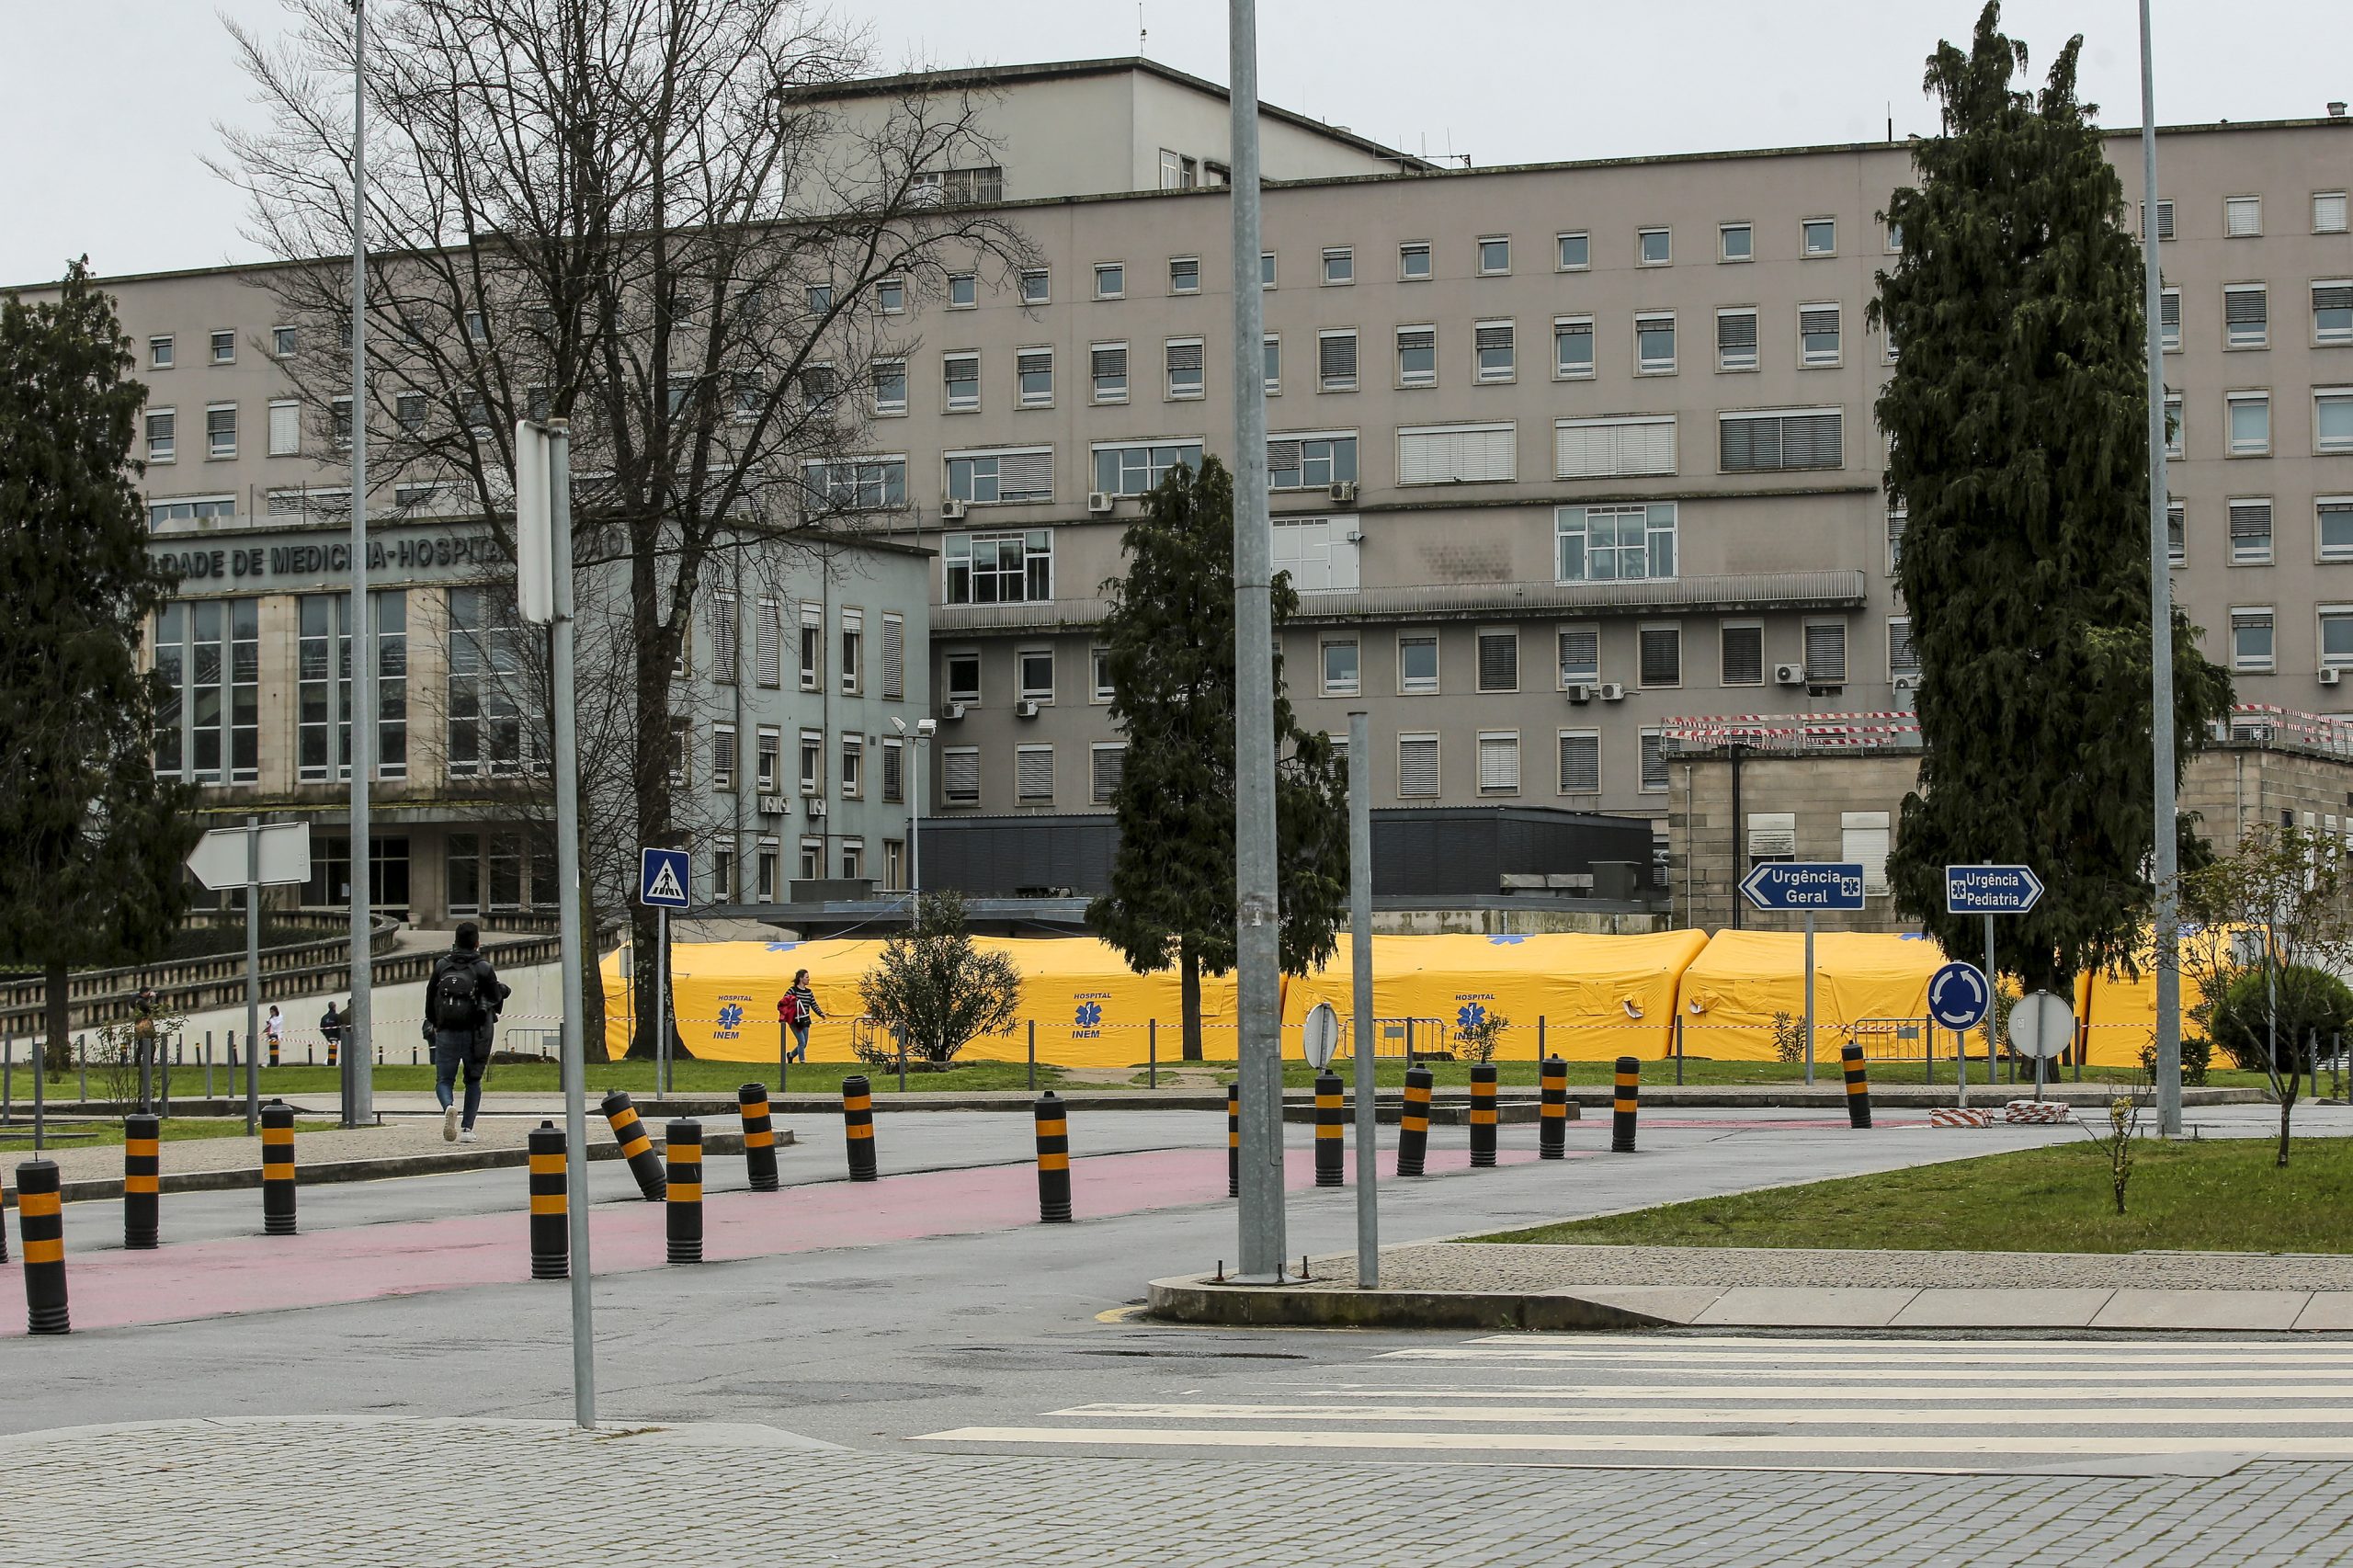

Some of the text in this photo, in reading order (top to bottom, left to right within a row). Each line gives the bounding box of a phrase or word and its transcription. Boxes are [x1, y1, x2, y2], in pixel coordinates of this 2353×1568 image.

[232, 548, 264, 577] DE
[1772, 869, 1841, 886] Urgência
[1966, 872, 2019, 889] Urgência
[1786, 889, 1828, 903] Geral
[1967, 892, 2020, 906] Pediatria
[713, 1031, 740, 1040] INEM
[1072, 1029, 1101, 1039] INEM
